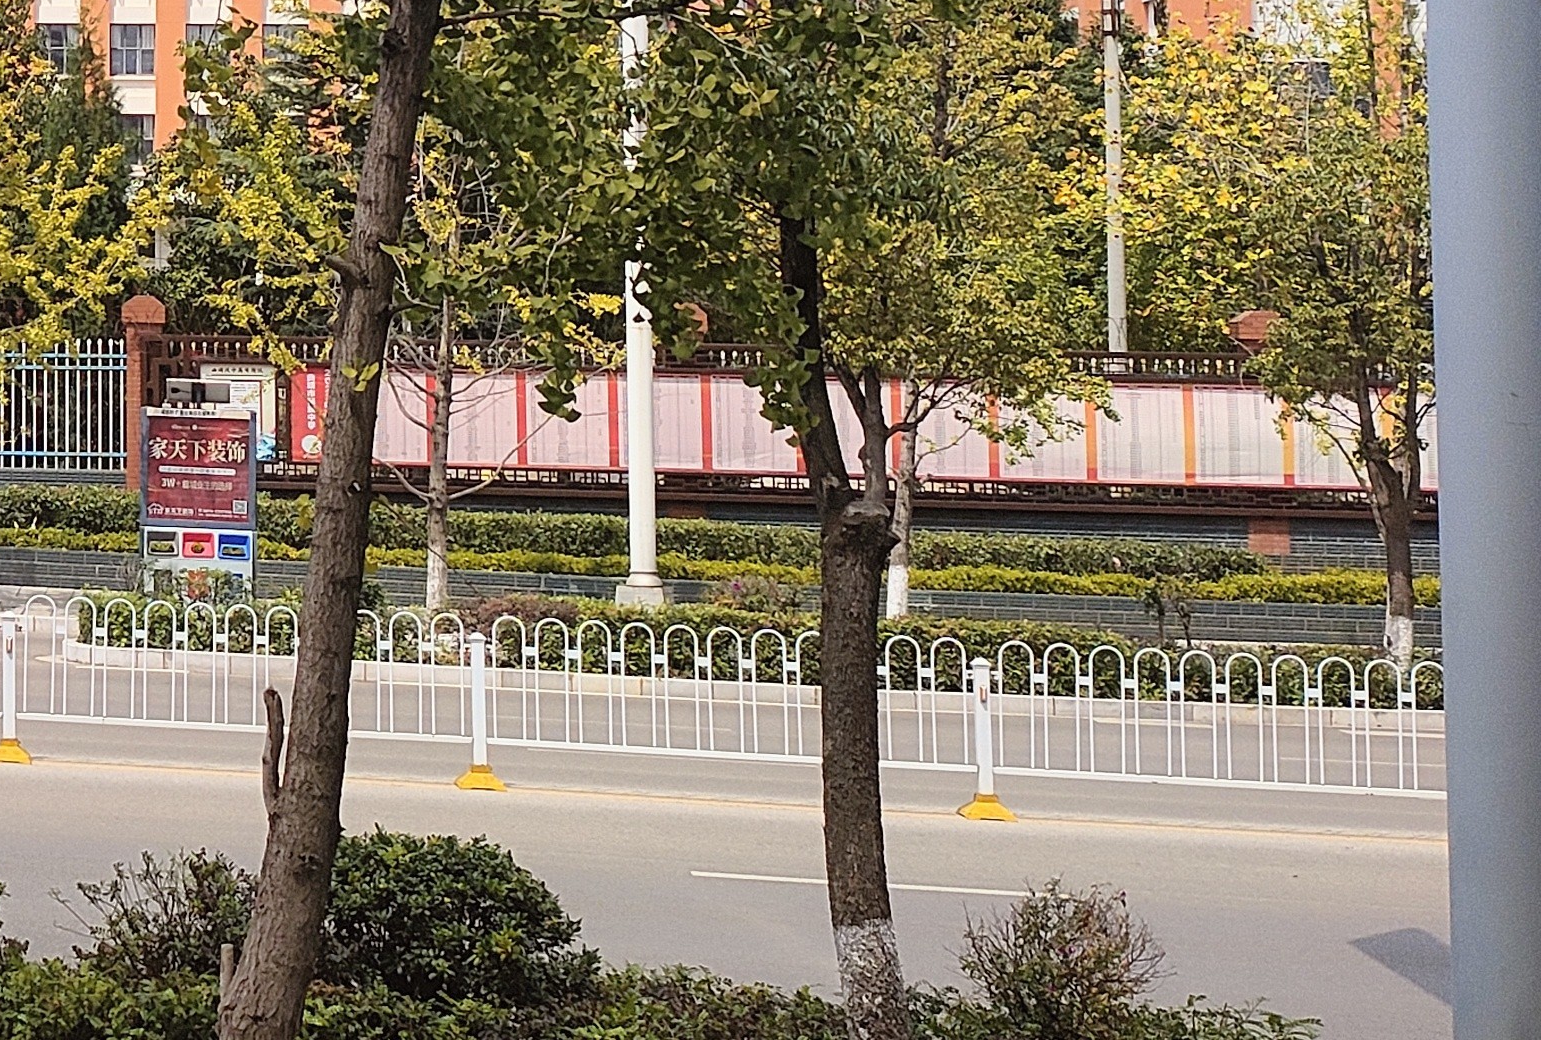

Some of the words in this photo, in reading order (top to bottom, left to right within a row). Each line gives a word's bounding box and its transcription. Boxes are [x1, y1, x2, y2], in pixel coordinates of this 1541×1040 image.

[148, 436, 247, 465] 家天下装饰
